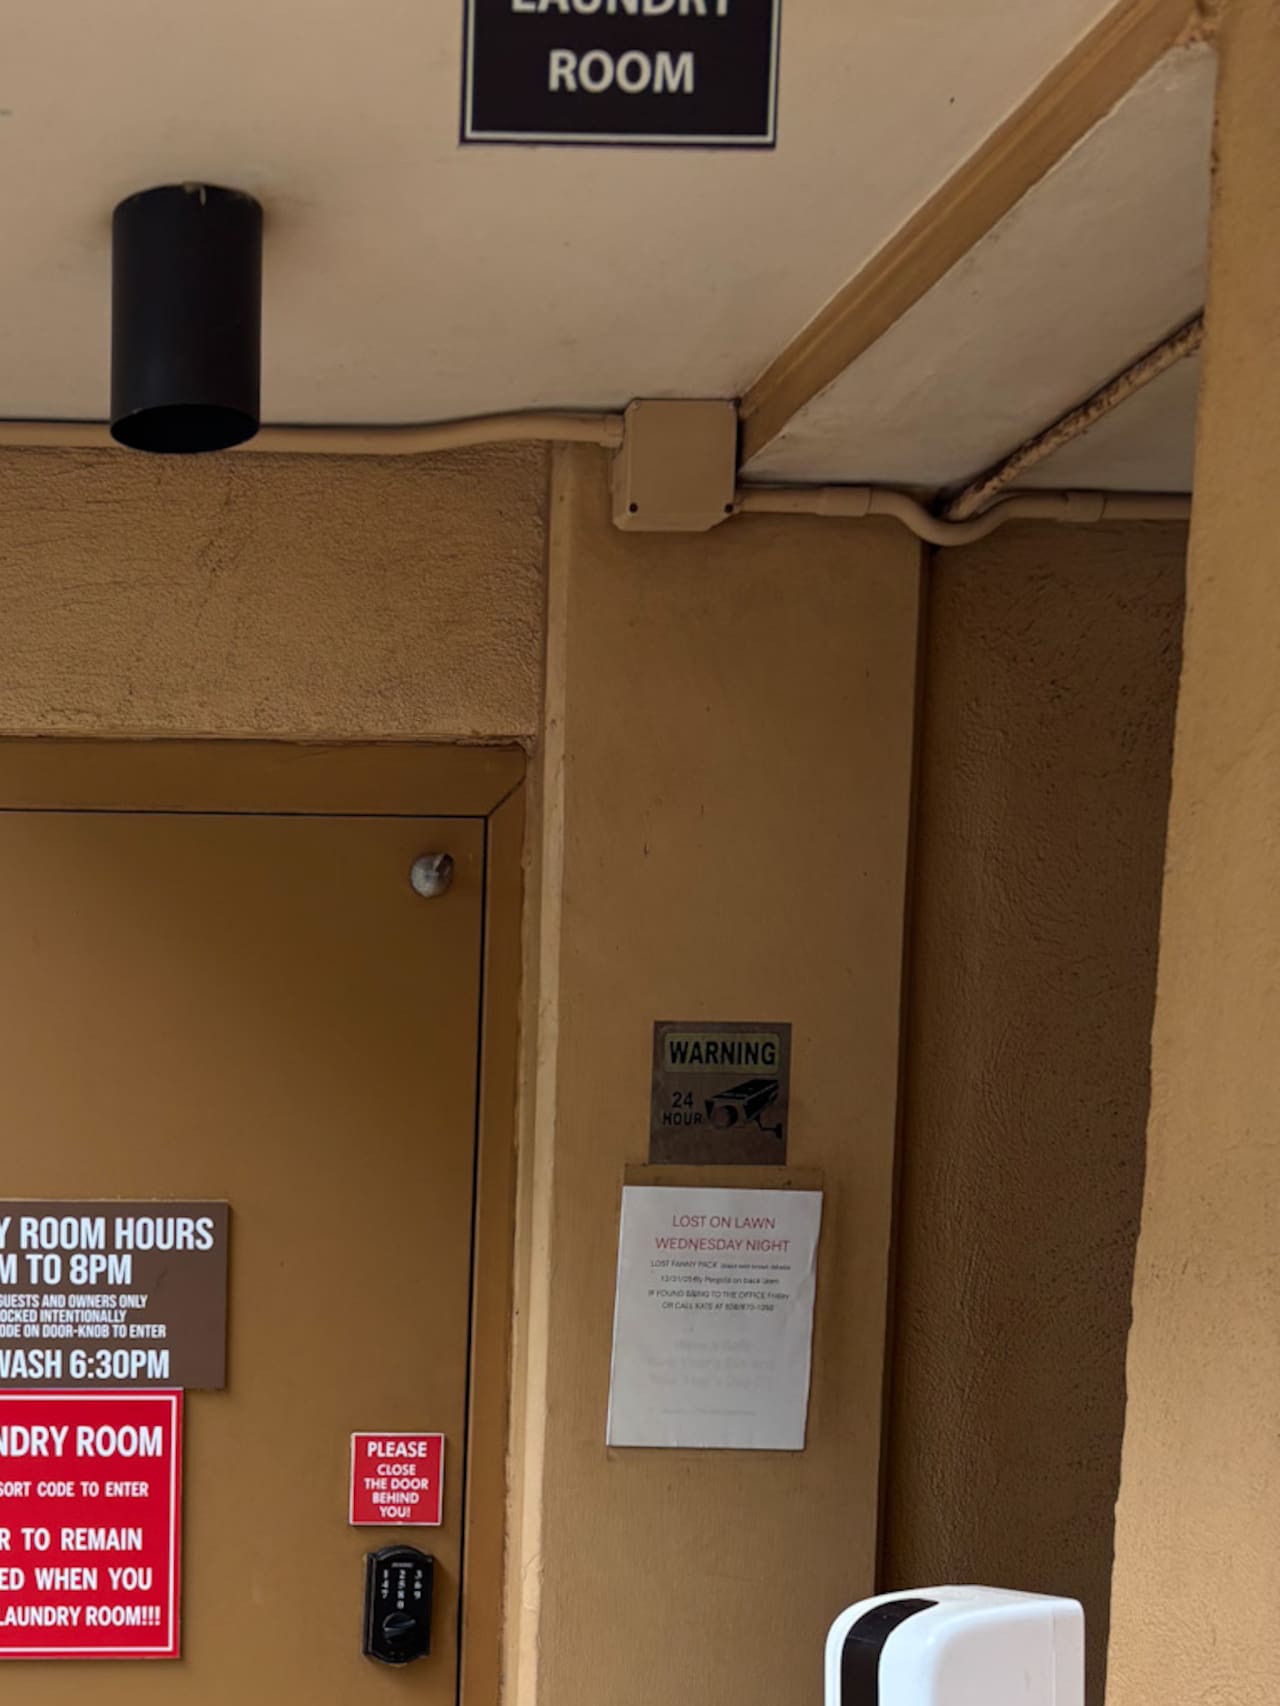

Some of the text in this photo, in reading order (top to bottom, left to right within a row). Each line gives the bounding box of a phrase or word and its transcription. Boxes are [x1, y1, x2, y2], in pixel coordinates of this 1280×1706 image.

[548, 48, 695, 94] ROOM
[669, 1040, 777, 1066] WARNING
[672, 1091, 694, 1109] 24
[662, 1112, 703, 1126] HOUR
[672, 1215, 776, 1230] LOST ON LAWN
[19, 1217, 106, 1250] ROOM
[115, 1217, 214, 1251] HOURS
[655, 1237, 790, 1252] WEDNESDAY NIGHT
[26, 1253, 62, 1285] TO
[69, 1254, 133, 1285] 8PM
[41, 1294, 66, 1308] AND
[68, 1294, 117, 1308] OWNERS
[119, 1294, 148, 1308] ONLY
[40, 1309, 127, 1323] INTENTIONALLY
[23, 1324, 39, 1338] ON
[42, 1324, 110, 1338] DOOR-KNOB
[112, 1324, 127, 1338] TO
[129, 1324, 167, 1338] ENTER
[69, 1349, 170, 1379] 6:30PM
[76, 1426, 163, 1457] ROOM
[367, 1441, 427, 1458] PLEASE
[376, 1464, 416, 1476] CLOSE
[37, 1481, 75, 1497] CODE
[80, 1482, 100, 1497] TO
[105, 1482, 149, 1497] ENTER
[363, 1478, 429, 1490] THE DOOR
[372, 1492, 420, 1504] BEHIND
[379, 1505, 411, 1518] YOU!
[21, 1528, 51, 1551] TO
[61, 1528, 143, 1551] REMAIN
[34, 1567, 98, 1591] WHEN
[108, 1567, 152, 1591] YOU
[85, 1605, 161, 1627] ROOM!!!
